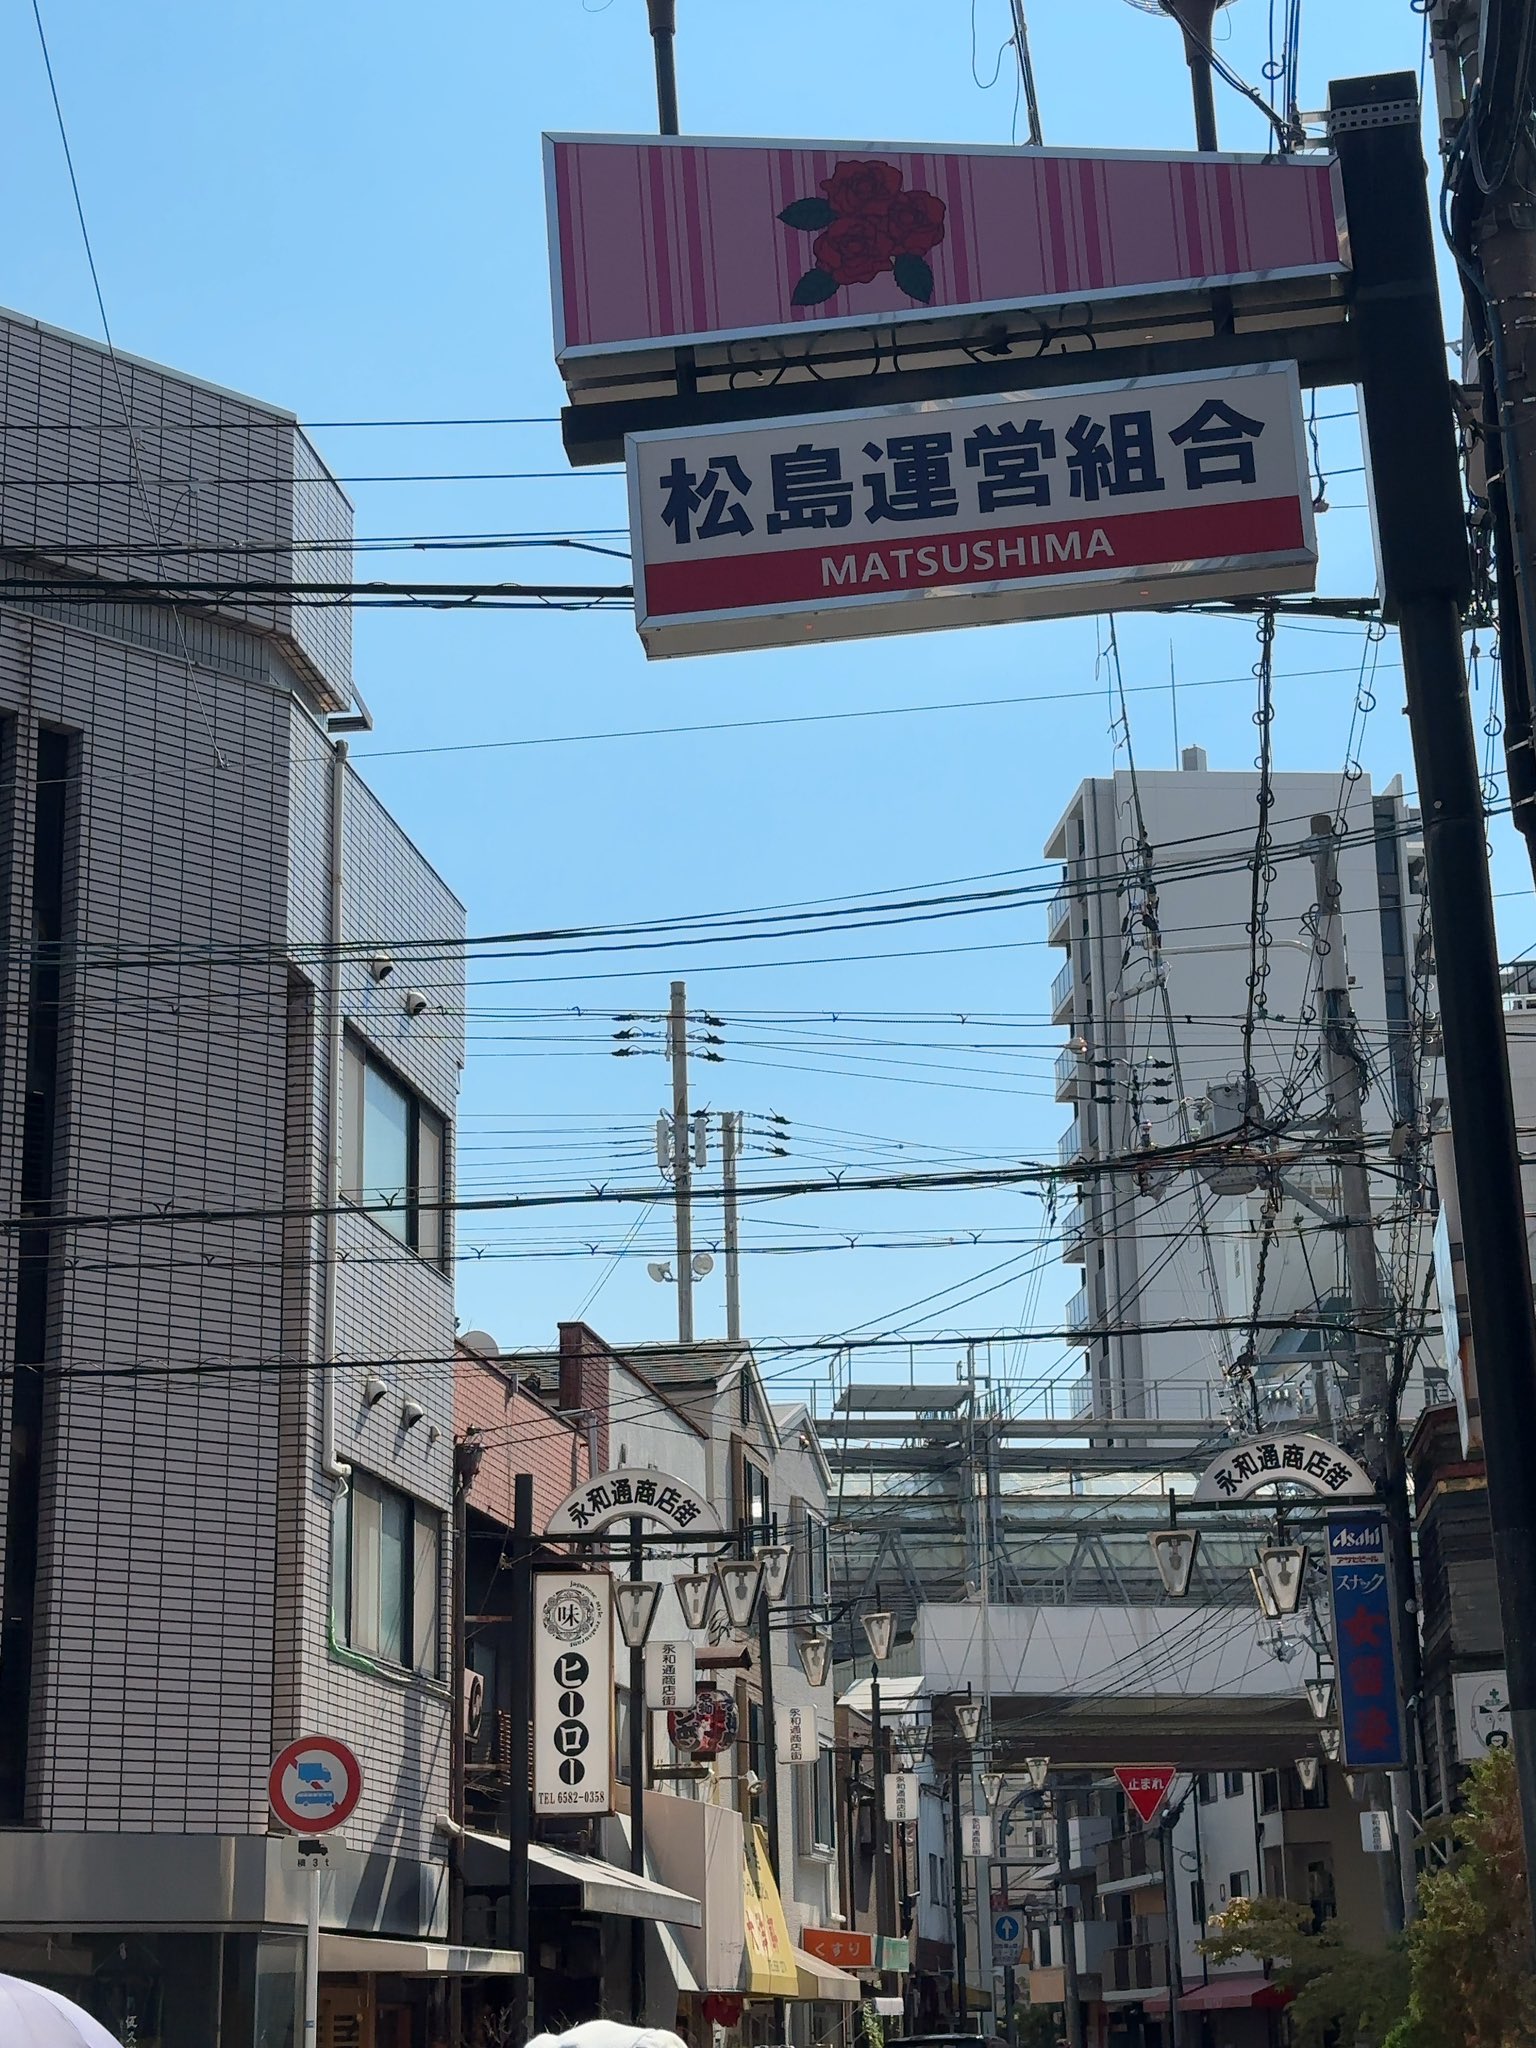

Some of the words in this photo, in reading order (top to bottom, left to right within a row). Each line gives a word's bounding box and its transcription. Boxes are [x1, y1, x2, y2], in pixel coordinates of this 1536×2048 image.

[659, 398, 1267, 545] 松島運営組合
[820, 528, 1115, 587] MATSUSHIMA
[1213, 1443, 1353, 1497] 永和通商店街
[567, 1477, 702, 1529] 永和通商店街
[1332, 1526, 1381, 1548] Asahi
[1336, 1555, 1379, 1564] アサヒビール
[1335, 1573, 1385, 1595] スナック
[557, 1603, 580, 1627] 味
[661, 1643, 677, 1706] 永和通商店街
[557, 1654, 586, 1786] ヒーロー
[789, 1707, 802, 1761] 永和通商店街
[538, 1792, 556, 1805] TEL
[557, 1790, 605, 1804] 6582-0358
[1127, 1777, 1165, 1791] 止まれ
[814, 1941, 861, 1957] くすり
